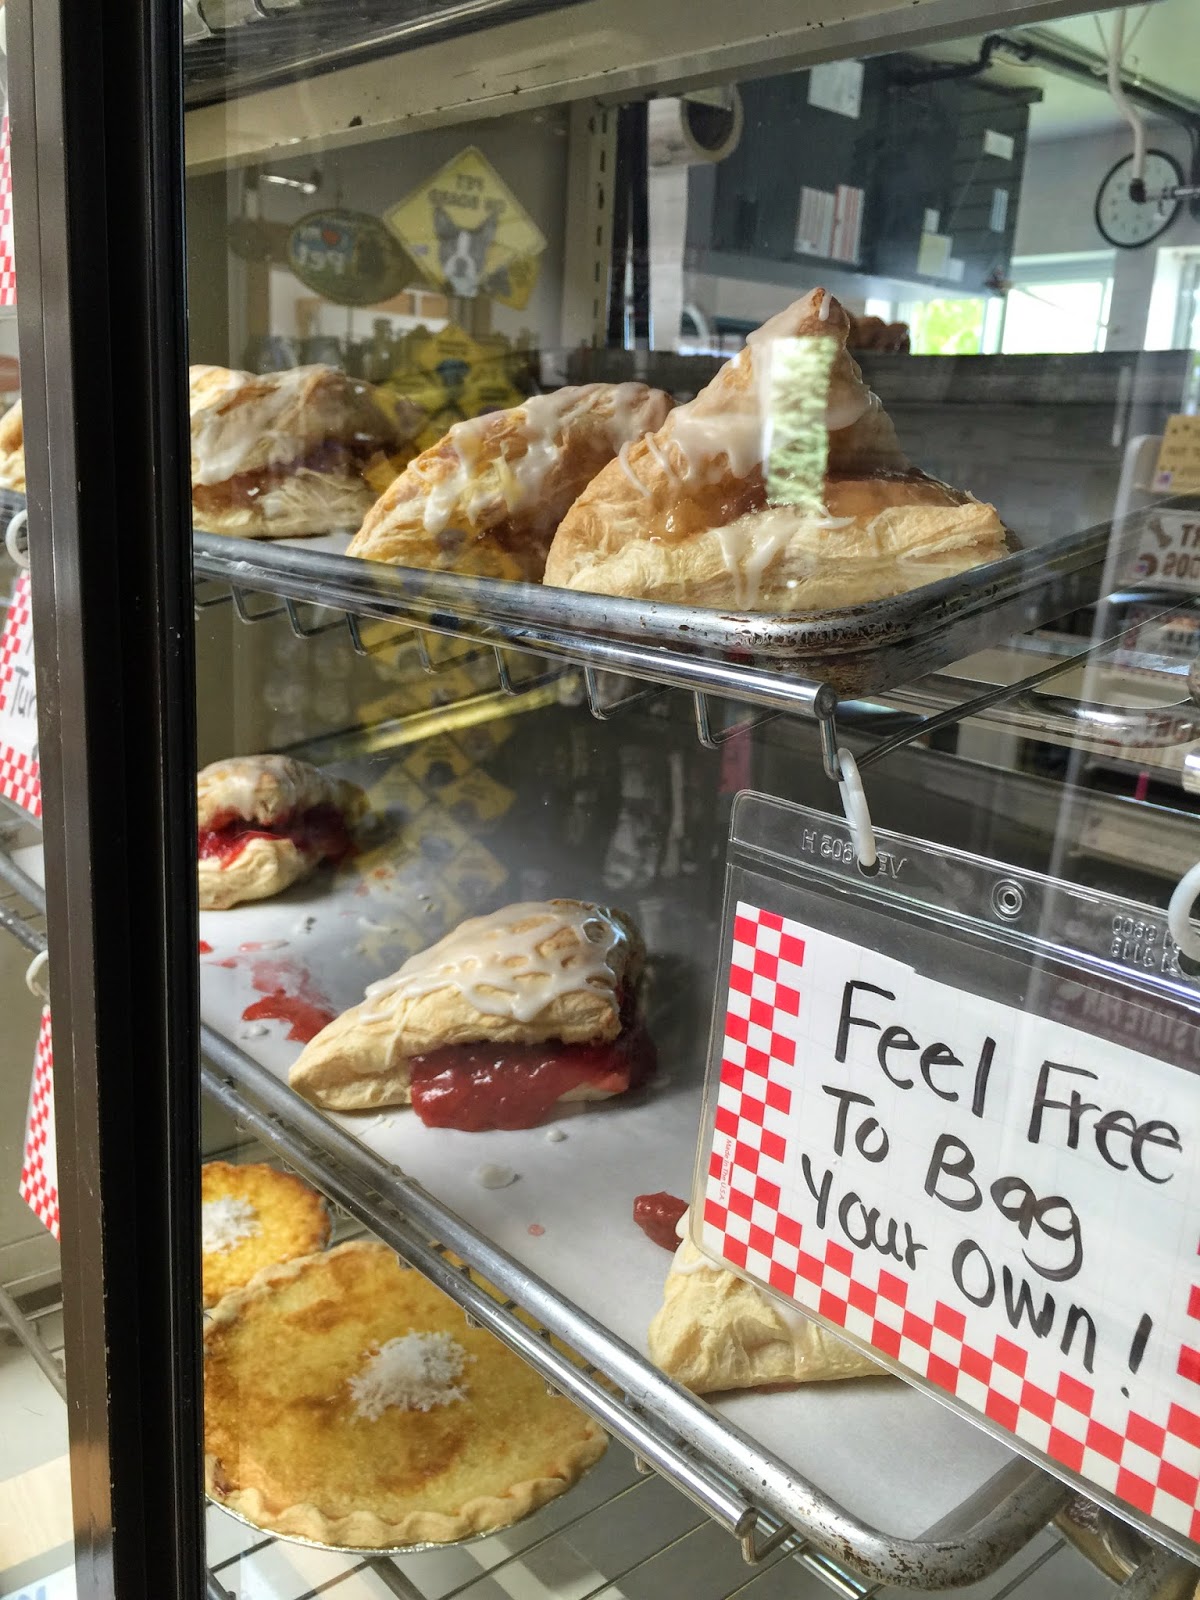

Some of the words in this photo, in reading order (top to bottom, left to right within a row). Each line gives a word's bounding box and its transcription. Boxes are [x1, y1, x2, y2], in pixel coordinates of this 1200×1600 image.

[835, 979, 997, 1118] Feel
[1028, 1060, 1183, 1184] Free
[801, 1153, 929, 1271] Your
[822, 1084, 890, 1163] To
[924, 1133, 1084, 1283] Bag
